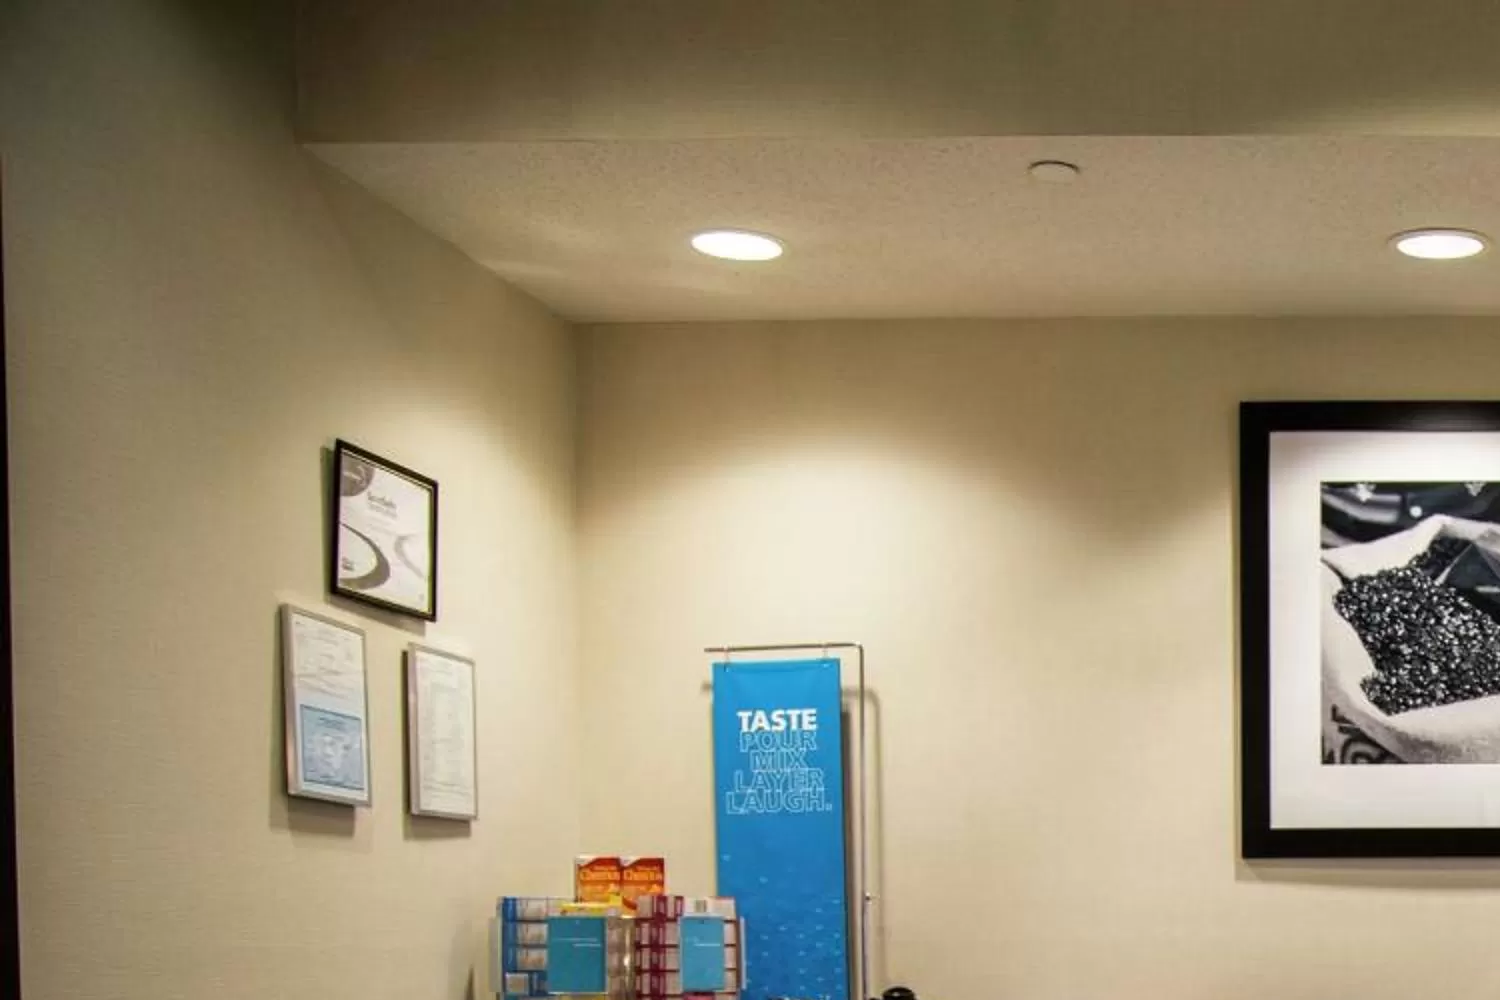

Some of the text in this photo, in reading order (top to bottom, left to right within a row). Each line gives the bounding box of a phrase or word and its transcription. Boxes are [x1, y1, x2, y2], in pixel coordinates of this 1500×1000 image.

[736, 708, 818, 732] TASTE
[740, 731, 817, 753] POUR
[750, 749, 809, 772] MIX
[733, 767, 825, 793] LAYER
